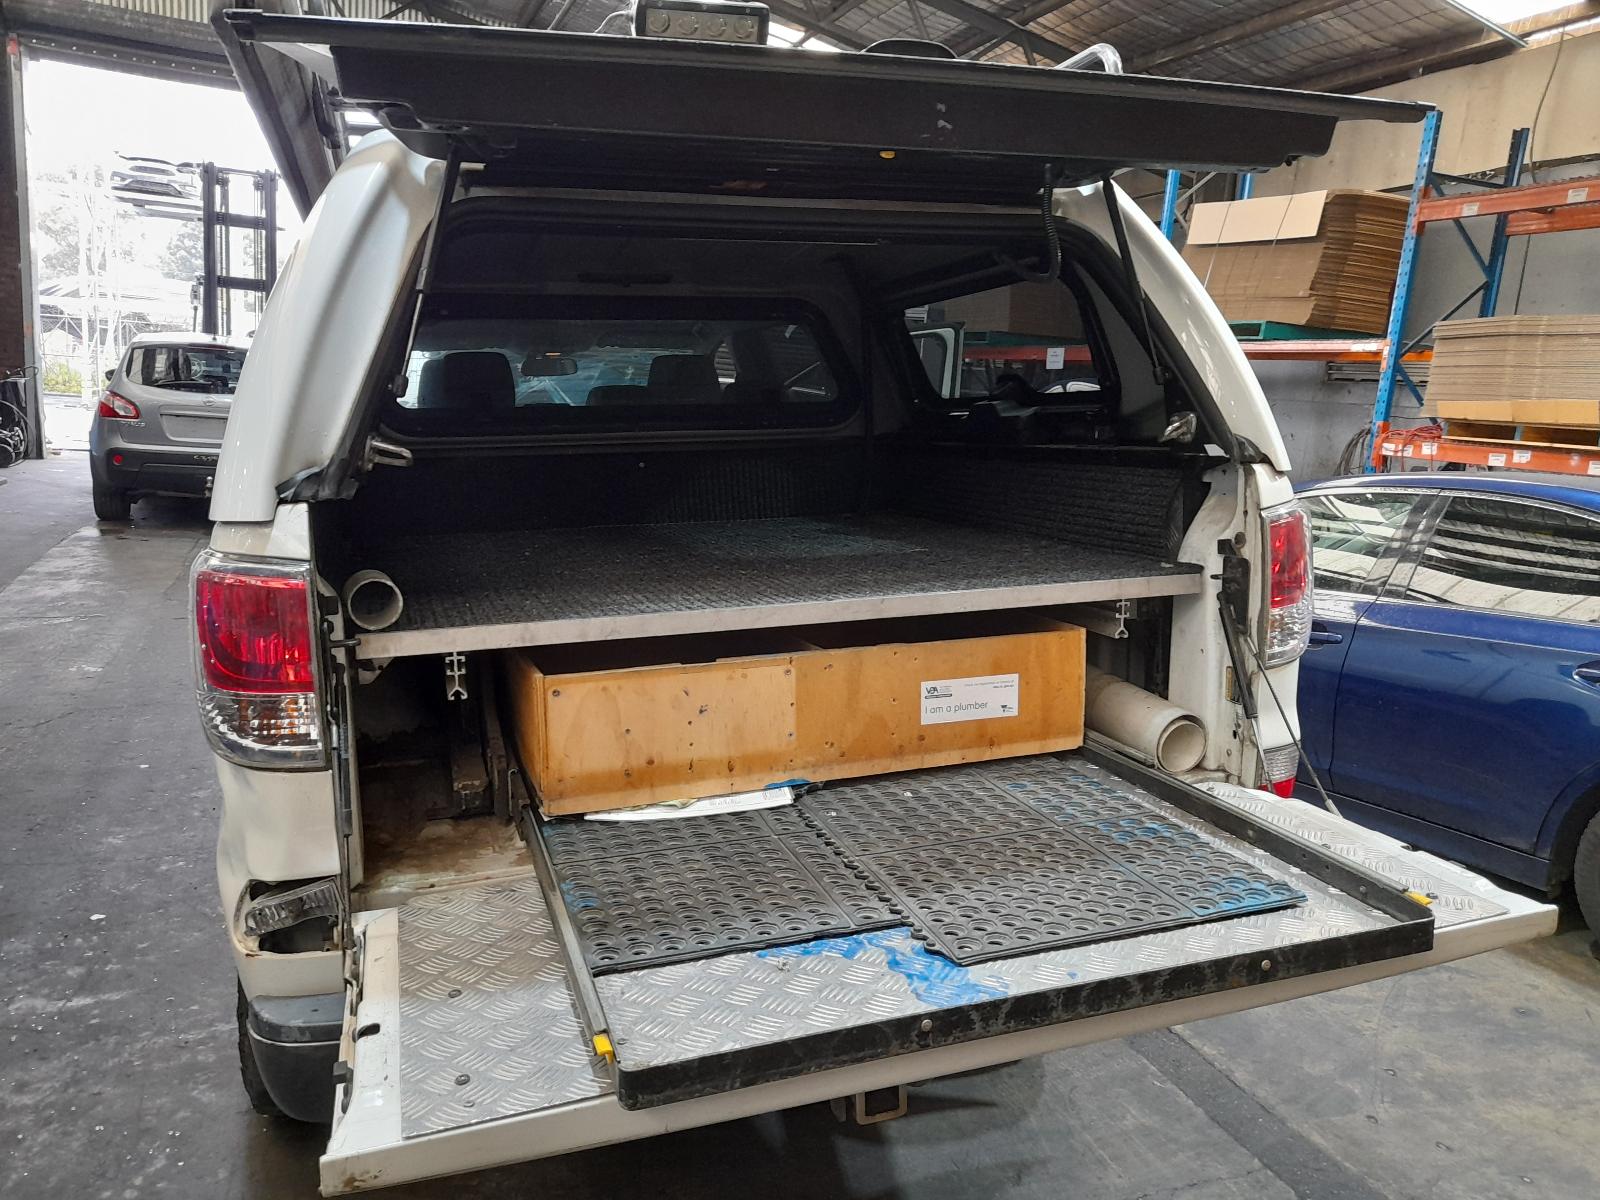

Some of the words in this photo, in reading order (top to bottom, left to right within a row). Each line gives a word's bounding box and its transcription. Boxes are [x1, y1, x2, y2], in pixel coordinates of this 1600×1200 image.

[930, 706, 944, 714] am
[946, 705, 952, 713] a
[954, 701, 989, 713] plumber
